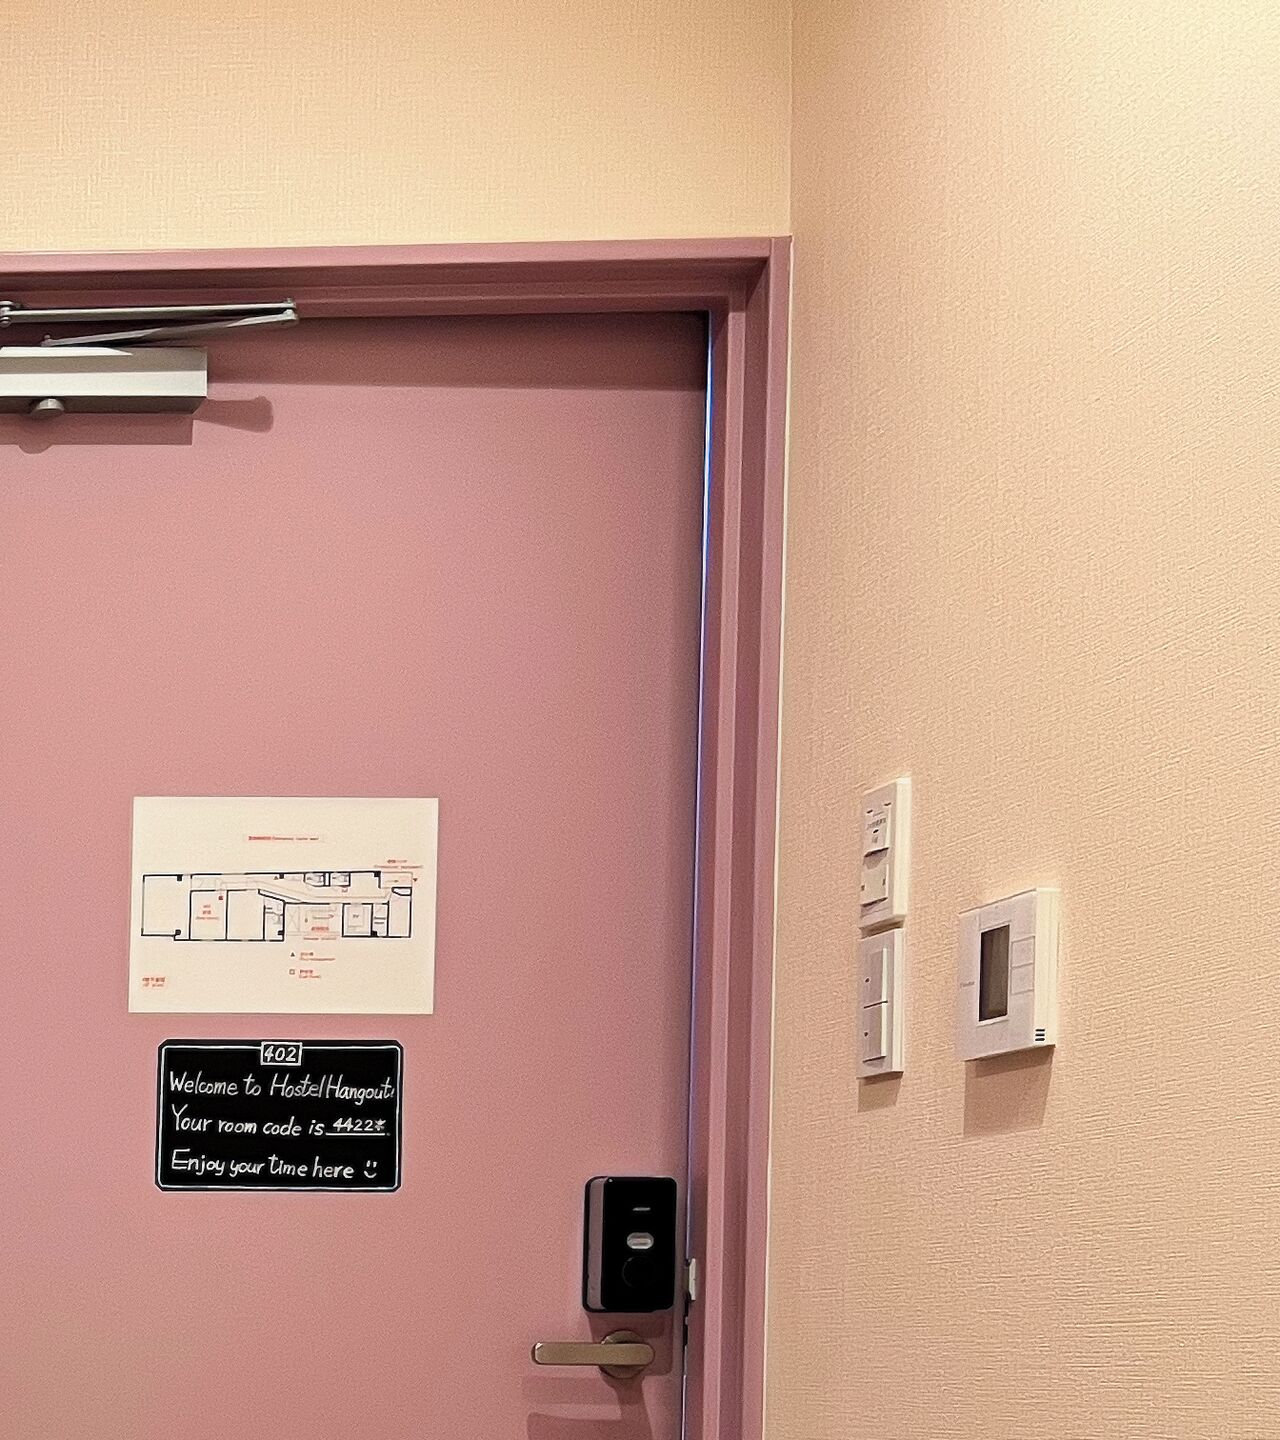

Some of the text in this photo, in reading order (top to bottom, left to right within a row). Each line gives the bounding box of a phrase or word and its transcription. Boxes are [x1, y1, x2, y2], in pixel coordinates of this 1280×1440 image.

[264, 1046, 297, 1062] 402
[169, 1070, 239, 1096] Welcome
[243, 1073, 262, 1096] to
[269, 1073, 327, 1098] Hostel
[171, 1103, 213, 1132] Your
[218, 1119, 257, 1134] room
[262, 1115, 302, 1136] code
[308, 1119, 325, 1136] is
[171, 1148, 355, 1179] Enjoy your time here
